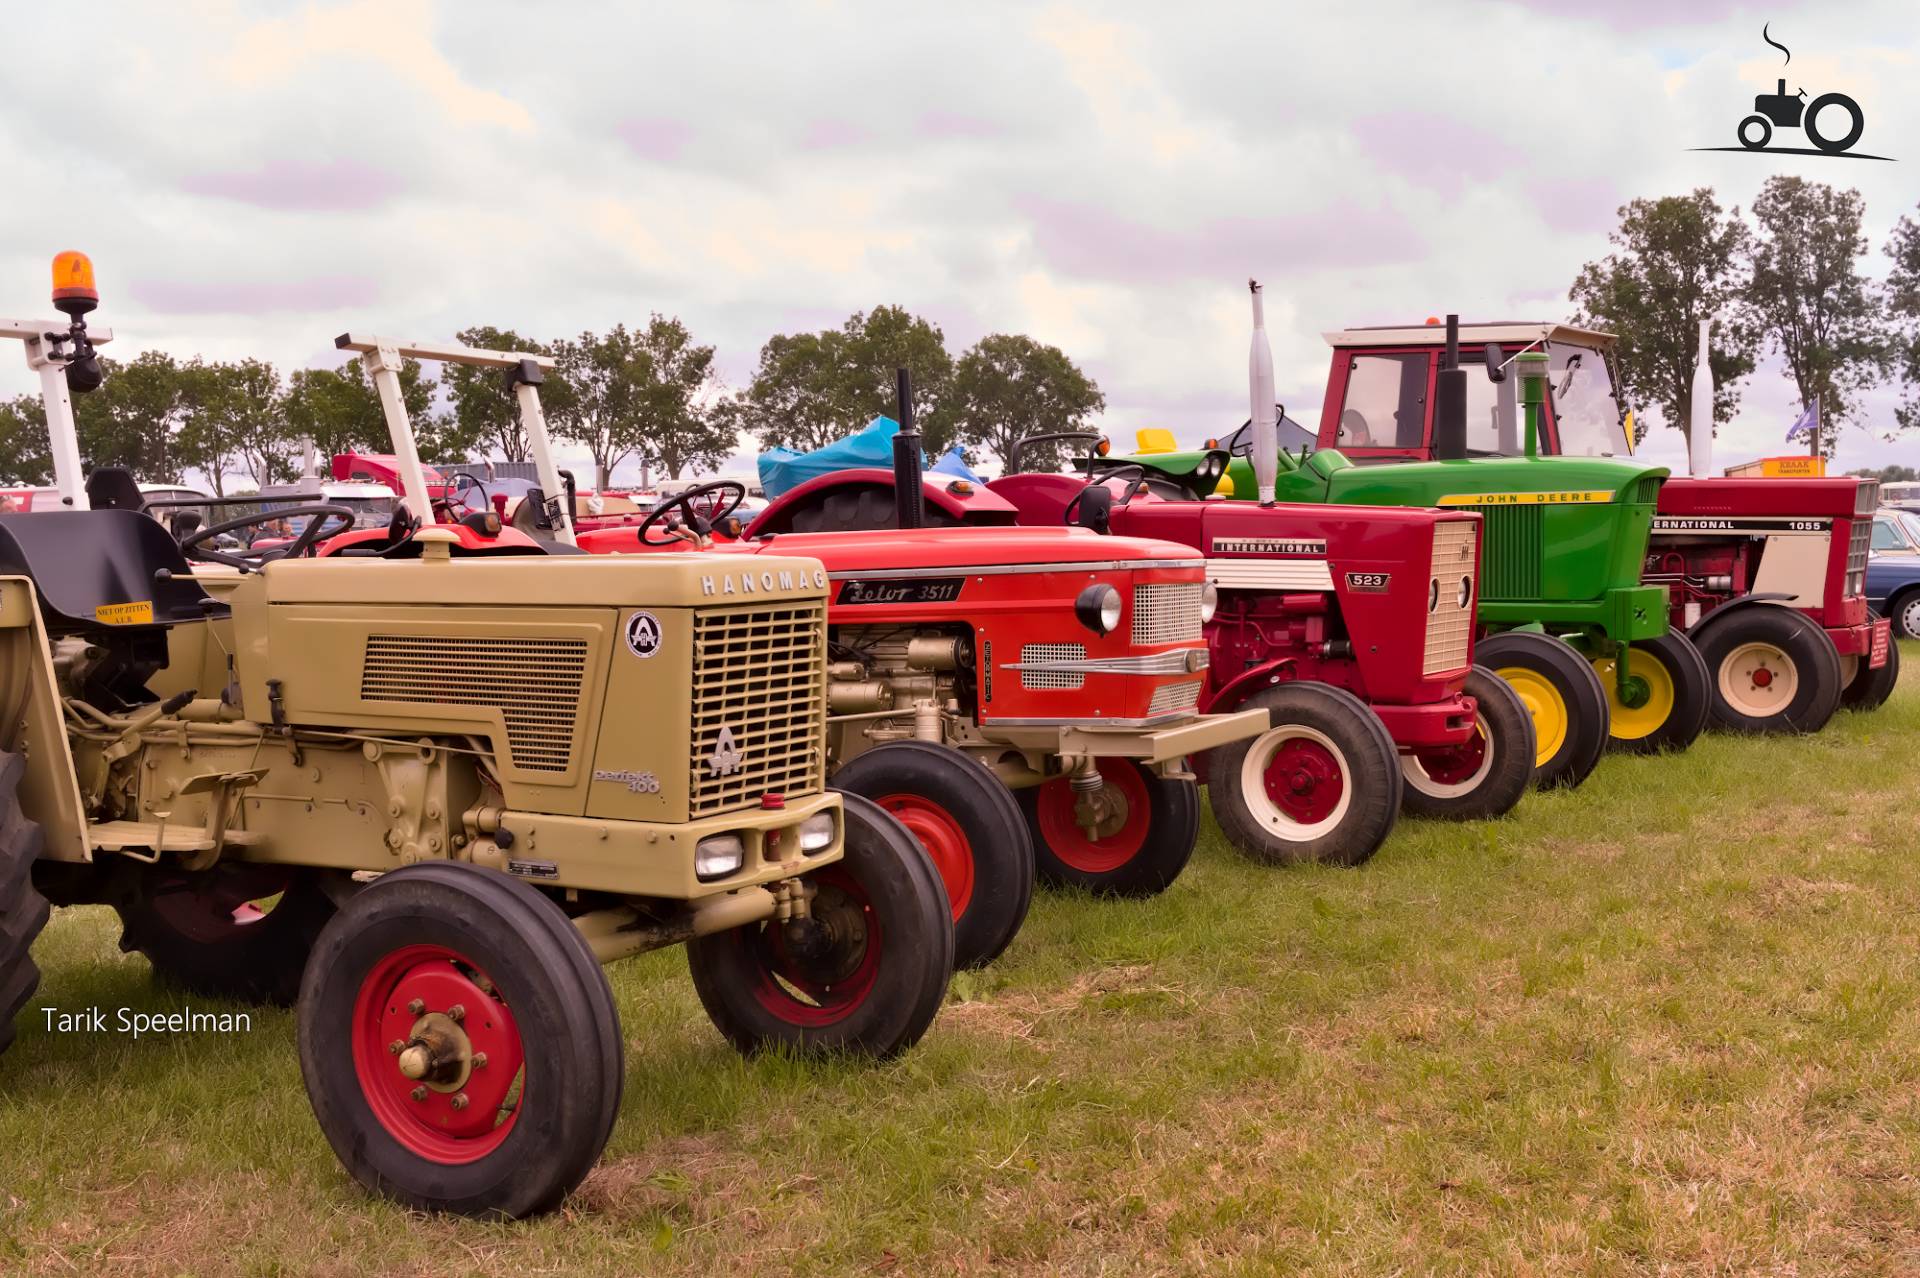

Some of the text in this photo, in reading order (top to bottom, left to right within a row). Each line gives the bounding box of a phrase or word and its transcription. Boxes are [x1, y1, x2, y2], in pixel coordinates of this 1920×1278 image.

[1476, 493, 1592, 504] JOHN DEERE
[1653, 520, 1822, 531] ERNATIONAL 1055
[1221, 543, 1319, 553] INTERNATIONAL
[701, 569, 825, 596] HANOMAG
[1353, 575, 1382, 586] 523
[918, 584, 955, 600] 3511
